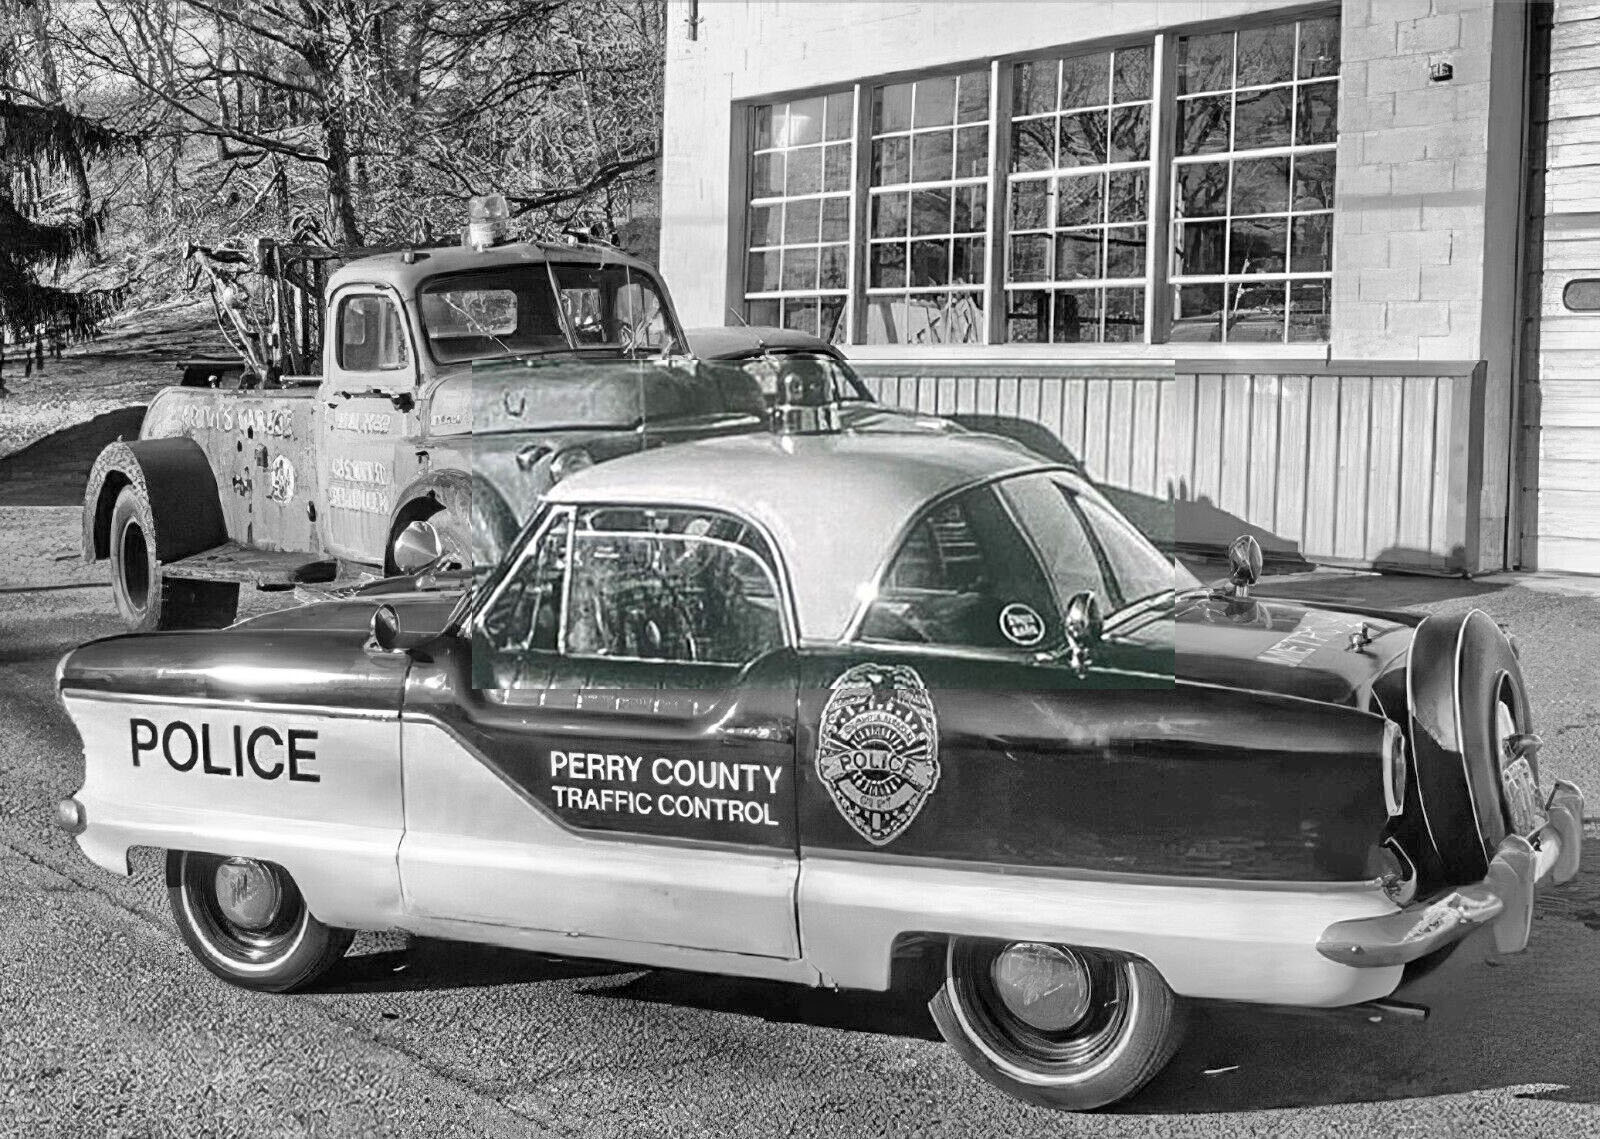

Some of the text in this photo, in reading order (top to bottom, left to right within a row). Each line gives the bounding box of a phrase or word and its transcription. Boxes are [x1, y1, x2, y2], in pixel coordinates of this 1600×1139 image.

[130, 718, 321, 782] POLICE
[839, 752, 914, 777] POLICE
[550, 750, 782, 794] PERRY COUNTY
[551, 785, 779, 826] TRAFFIC CONTROL
